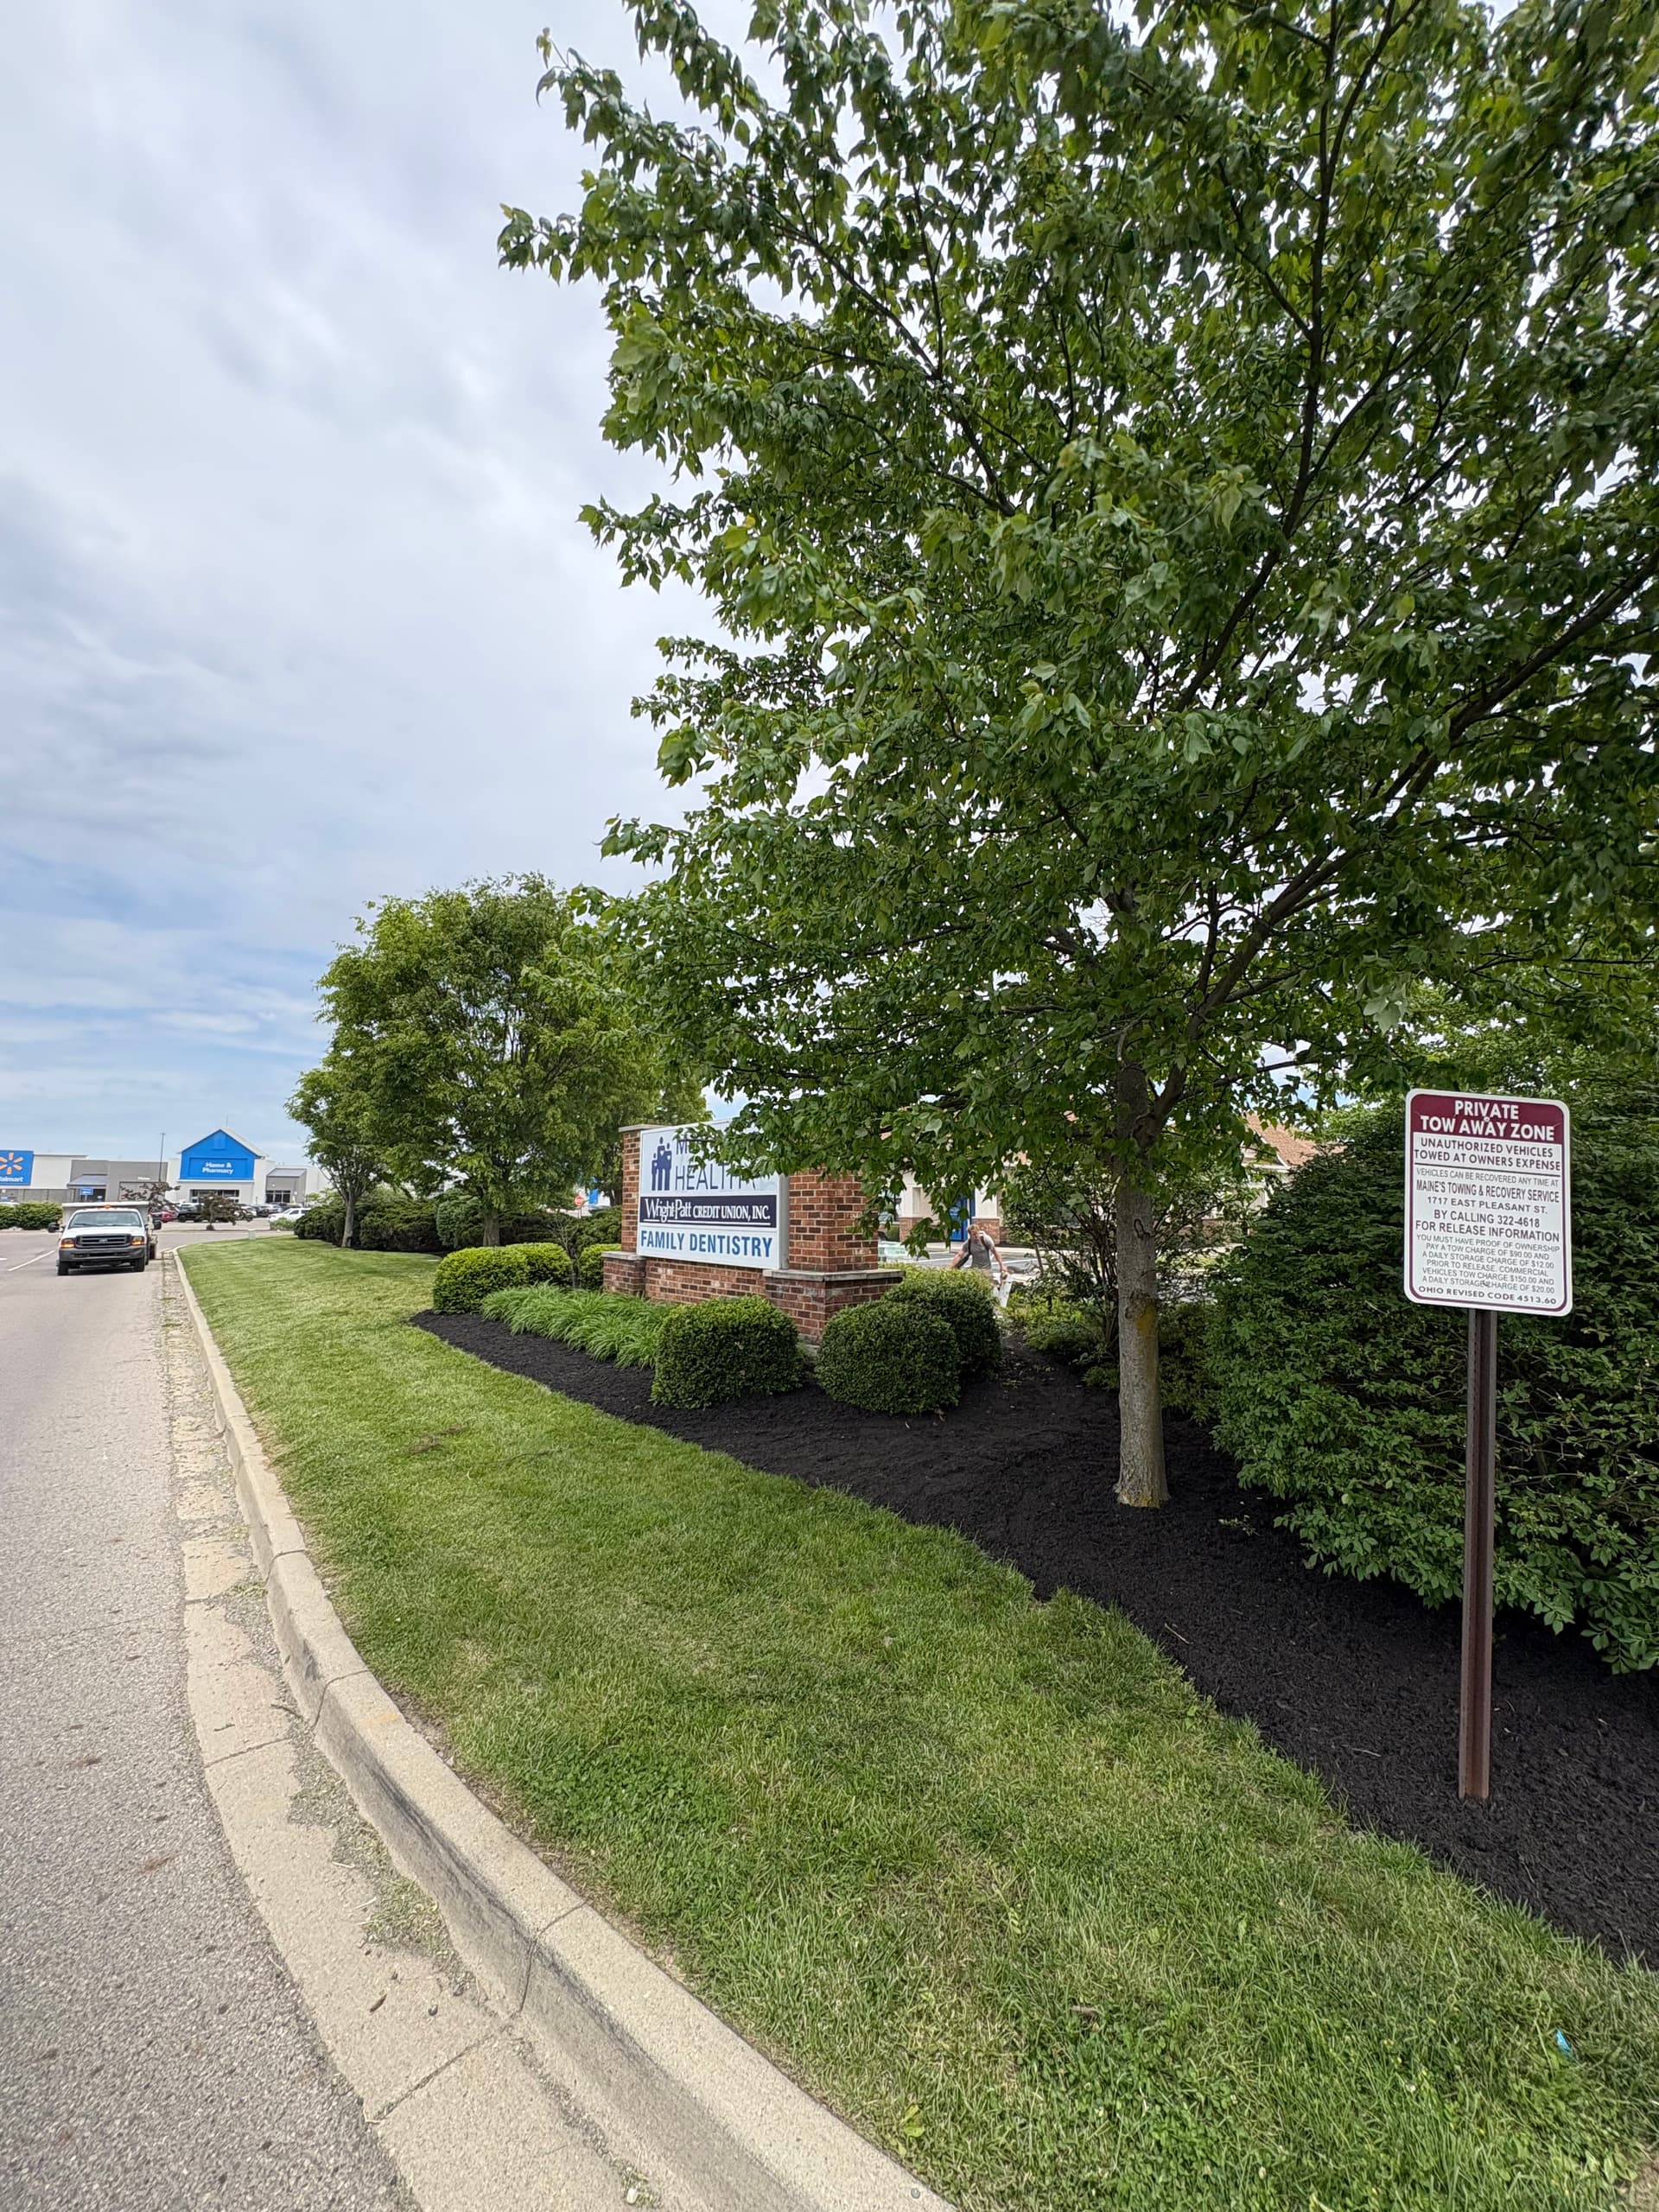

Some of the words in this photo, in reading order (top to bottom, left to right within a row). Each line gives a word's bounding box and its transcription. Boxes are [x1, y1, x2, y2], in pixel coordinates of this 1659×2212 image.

[1455, 1100, 1519, 1119] PRIVATE
[1421, 1116, 1456, 1133] TOW
[1459, 1119, 1510, 1137] AWAY
[1511, 1123, 1554, 1141] ZONE
[1421, 1137, 1503, 1154] UNAUTHORIZED
[1506, 1145, 1553, 1158] VEHICLES
[1414, 1150, 1450, 1161] TOWED
[1453, 1154, 1466, 1163] AT
[1469, 1154, 1513, 1167] OWNERS
[1516, 1159, 1560, 1171] EXPENSE
[1417, 1168, 1448, 1178] VEHICLES
[1476, 1173, 1516, 1184] RECOVERED
[1518, 1176, 1532, 1185] ANY
[1534, 1178, 1548, 1186] TIME
[1417, 1179, 1446, 1193] MAINE'S
[1447, 1182, 1477, 1196] TOWING
[1479, 1185, 1484, 1196] &
[1486, 1185, 1526, 1200] RECOVERY
[1528, 1189, 1559, 1203] SERVICE
[693, 1205, 721, 1218] CREDIT
[721, 1205, 751, 1222] UNION,
[752, 1205, 771, 1219] INC.
[1451, 1198, 1476, 1207] EAST
[1479, 1201, 1531, 1212] PLEASANT
[1434, 1210, 1447, 1219] BY
[1451, 1211, 1494, 1224] CALLING
[1497, 1215, 1540, 1228] 322-4618
[1416, 1221, 1435, 1230] FOR
[1440, 1223, 1485, 1236] RELEASE
[1489, 1227, 1559, 1242] INFORMATION
[640, 1230, 685, 1250] FAMILY
[690, 1233, 772, 1257] DENTISTRY
[1465, 1246, 1495, 1255] CHARGE
[1476, 1239, 1501, 1248] PROOF
[1516, 1243, 1560, 1252] OWNERSHIP
[1427, 1259, 1449, 1268] PRIOR
[1499, 1266, 1548, 1277] COMMERCIAL
[1450, 1253, 1484, 1262] STORAGE
[1487, 1255, 1516, 1265] CHARGE
[1531, 1260, 1554, 1268] $12.00
[1422, 1268, 1457, 1277] VEHICLES
[1459, 1270, 1476, 1279] TOW
[1478, 1272, 1508, 1281] CHARGE
[1510, 1275, 1536, 1284] $150.00
[1450, 1279, 1484, 1287] STORAGE
[1531, 1285, 1554, 1294] $20.00
[1446, 1288, 1484, 1298] REVISED
[1487, 1292, 1514, 1301] CODE
[1517, 1294, 1556, 1305] 4513.60
